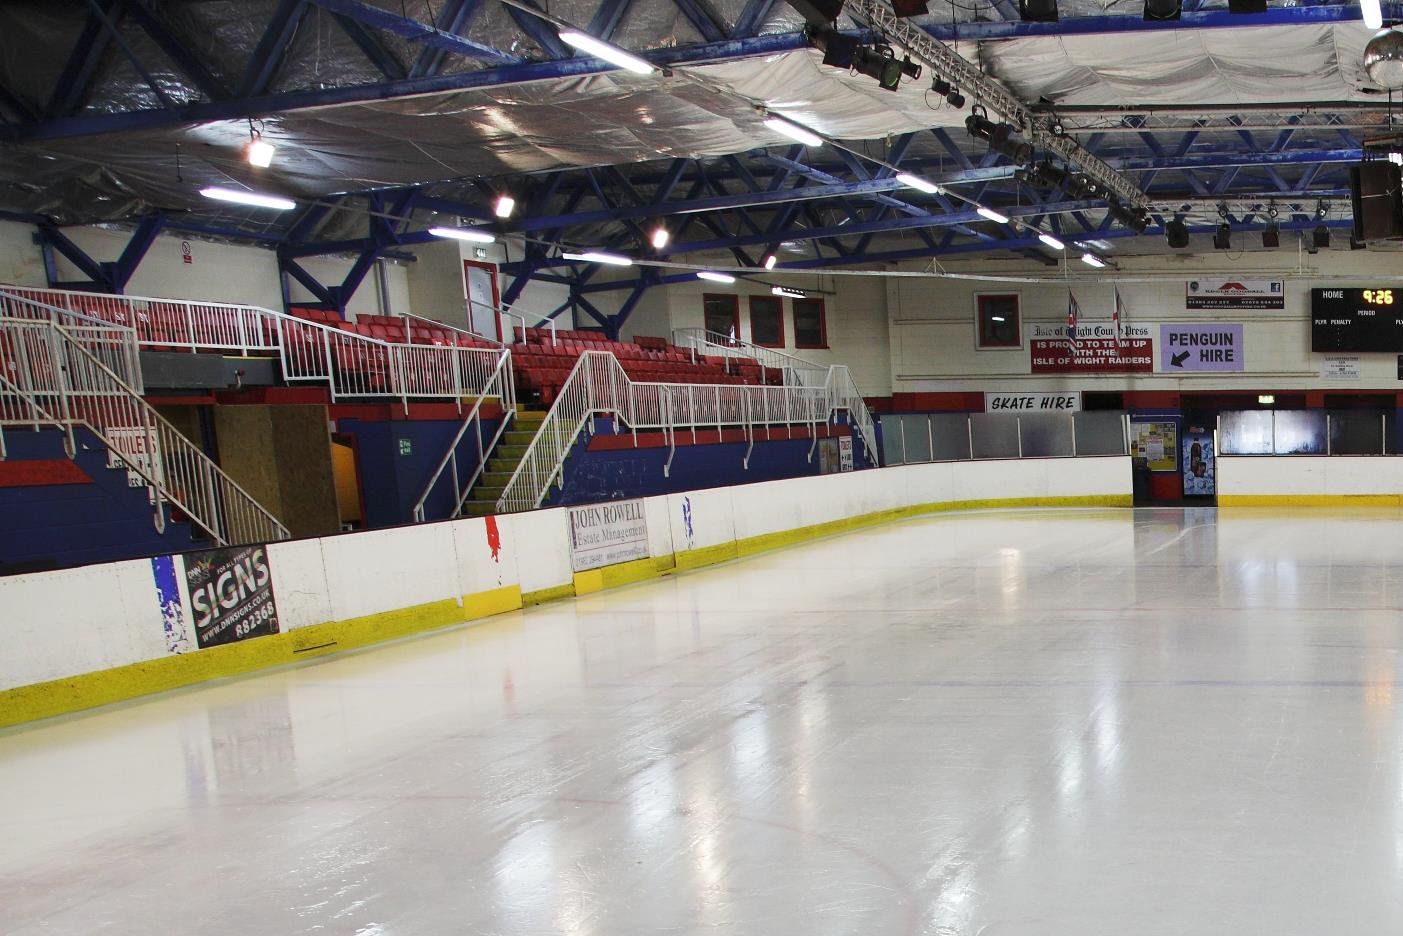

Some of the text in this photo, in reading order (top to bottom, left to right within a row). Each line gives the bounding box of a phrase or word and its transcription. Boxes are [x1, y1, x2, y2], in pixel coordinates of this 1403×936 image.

[1322, 290, 1344, 299] HOME
[1362, 289, 1394, 305] 9:26
[1055, 324, 1063, 336] of
[1065, 325, 1092, 337] ight
[1125, 325, 1149, 337] Press
[1169, 332, 1234, 346] PENGUIN
[1074, 357, 1106, 365] WIGHT
[1200, 349, 1234, 363] HIRE
[991, 396, 1076, 410] SKATE HIRE
[575, 502, 644, 530] JOHN ROWELL
[577, 525, 645, 546] Estate Management
[216, 565, 226, 575] FOR
[226, 562, 234, 570] ALL
[192, 549, 269, 628] SIGNS
[202, 588, 271, 643] WWW.DNNSIGNS.CO.UK
[235, 601, 275, 638] 882368
